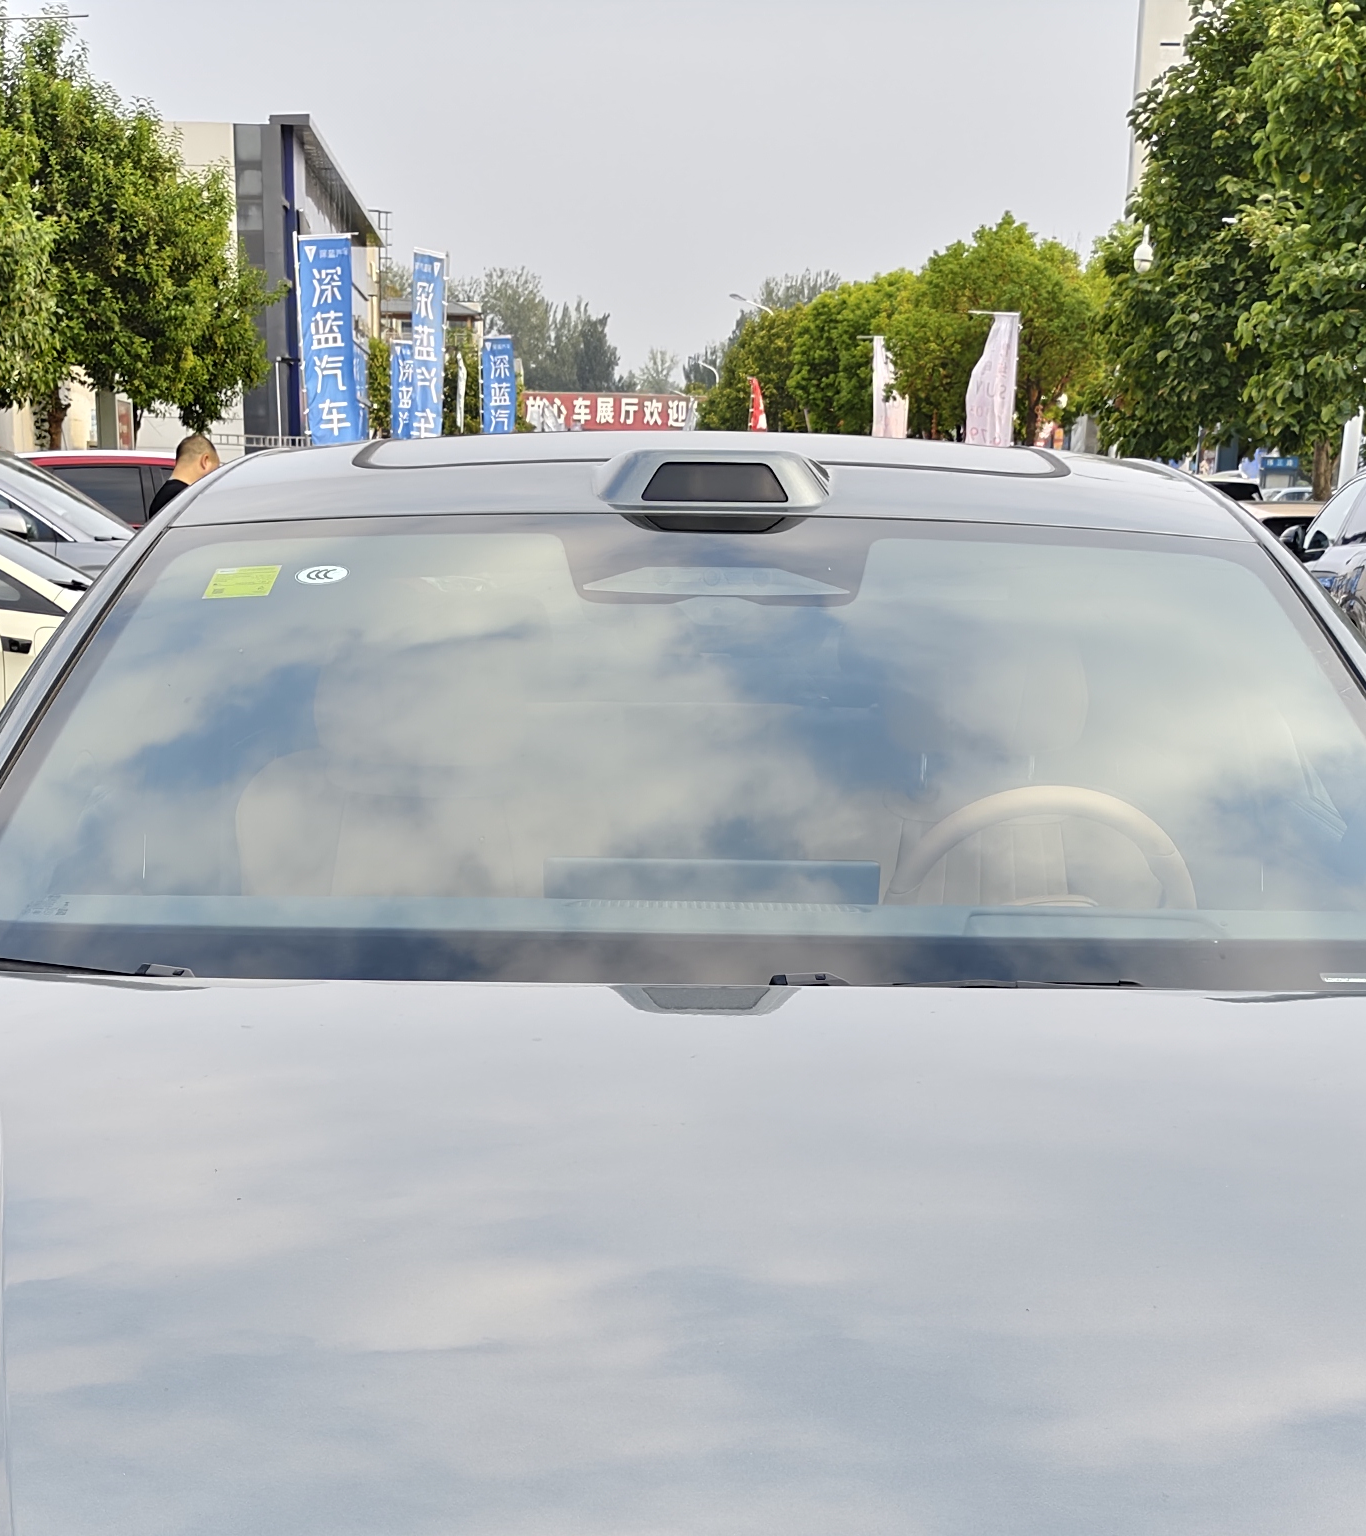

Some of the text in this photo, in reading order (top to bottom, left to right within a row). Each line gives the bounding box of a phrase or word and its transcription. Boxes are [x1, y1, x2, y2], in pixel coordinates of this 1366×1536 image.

[311, 266, 351, 436] 深蓝汽车
[489, 354, 511, 432] 深蓝汽
[525, 396, 700, 427] 放心车展厅欢迎
